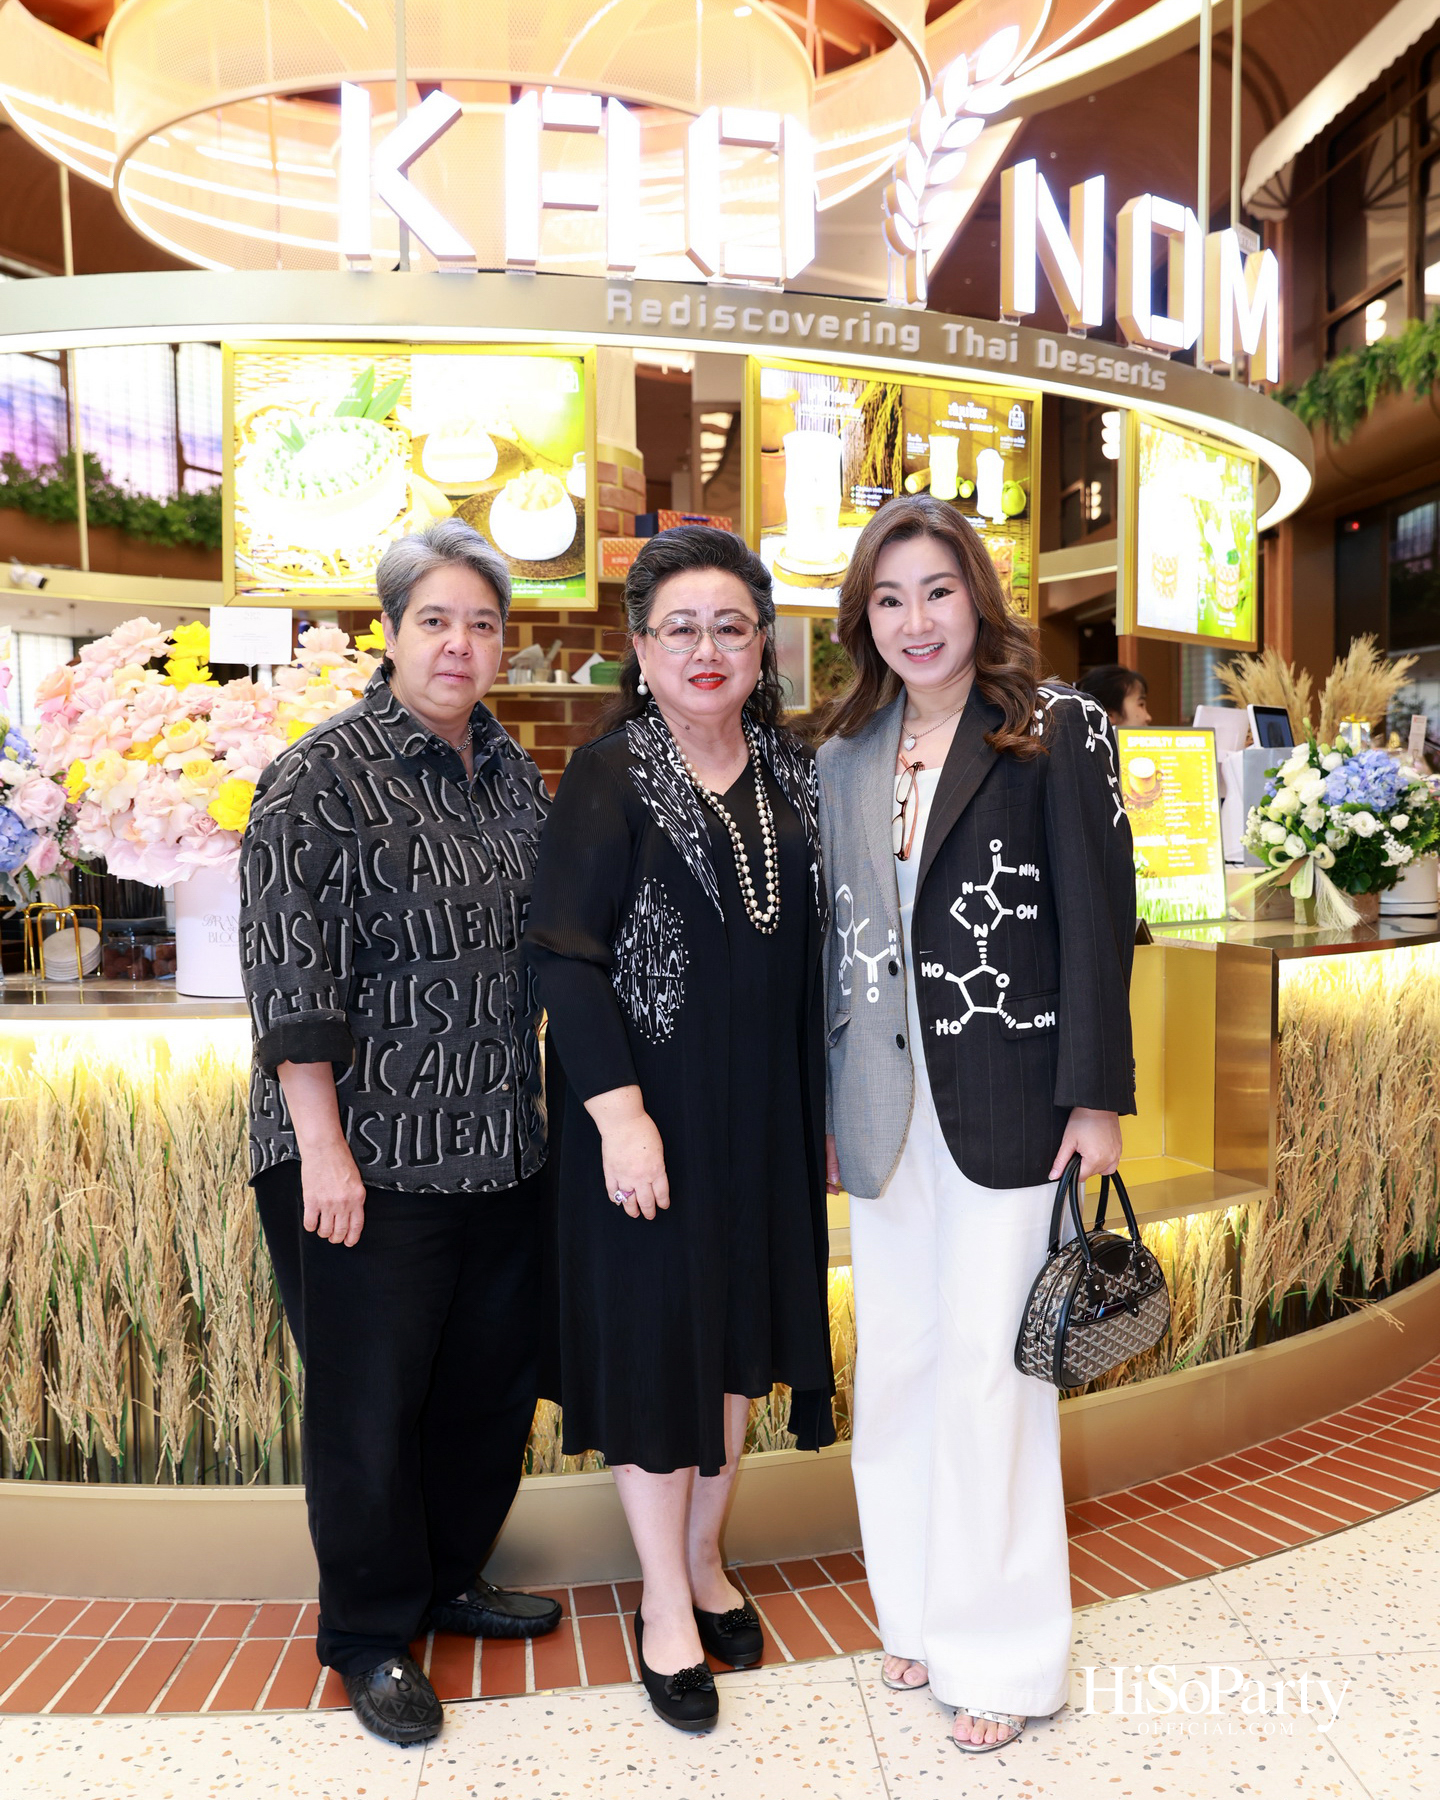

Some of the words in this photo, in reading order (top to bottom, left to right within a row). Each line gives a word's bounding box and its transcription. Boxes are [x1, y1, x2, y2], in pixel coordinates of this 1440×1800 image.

[1000, 157, 1279, 384] NOM
[606, 288, 921, 354] Rediscovering
[943, 323, 1018, 363] Thai
[1037, 337, 1168, 391] Desserts
[1016, 904, 1038, 920] OH
[921, 962, 944, 978] HO
[1033, 1011, 1056, 1028] OH
